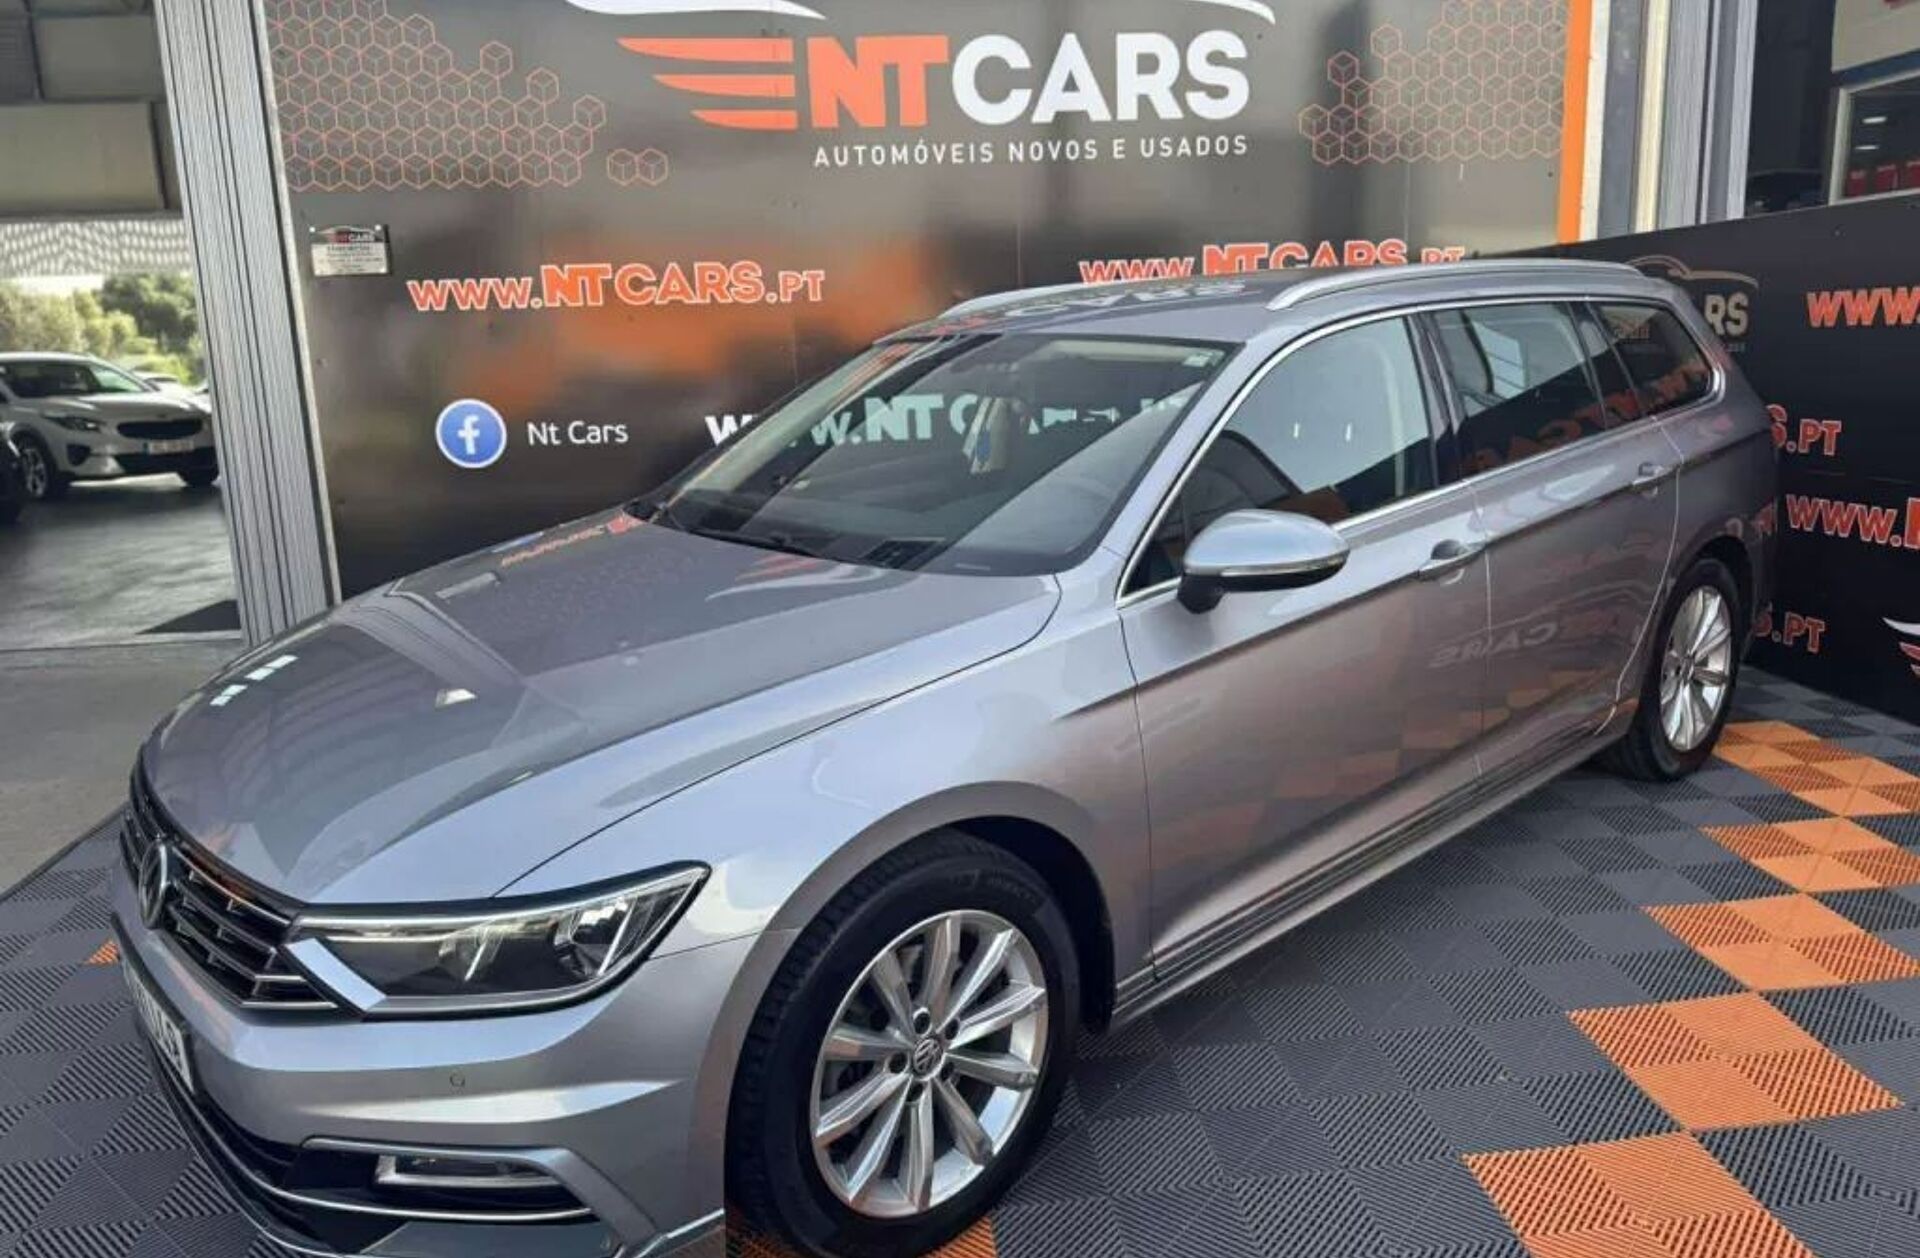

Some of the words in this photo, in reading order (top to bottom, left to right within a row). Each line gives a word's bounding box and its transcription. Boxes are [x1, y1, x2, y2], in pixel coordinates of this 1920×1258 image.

[806, 29, 1250, 128] NTCARS
[815, 138, 993, 167] AUTOMÓVEIS
[1009, 139, 1098, 163] NOVOS
[1113, 139, 1126, 160] E
[1140, 135, 1248, 158] USADOS
[527, 421, 561, 446] Nt
[569, 420, 629, 445] Cars
